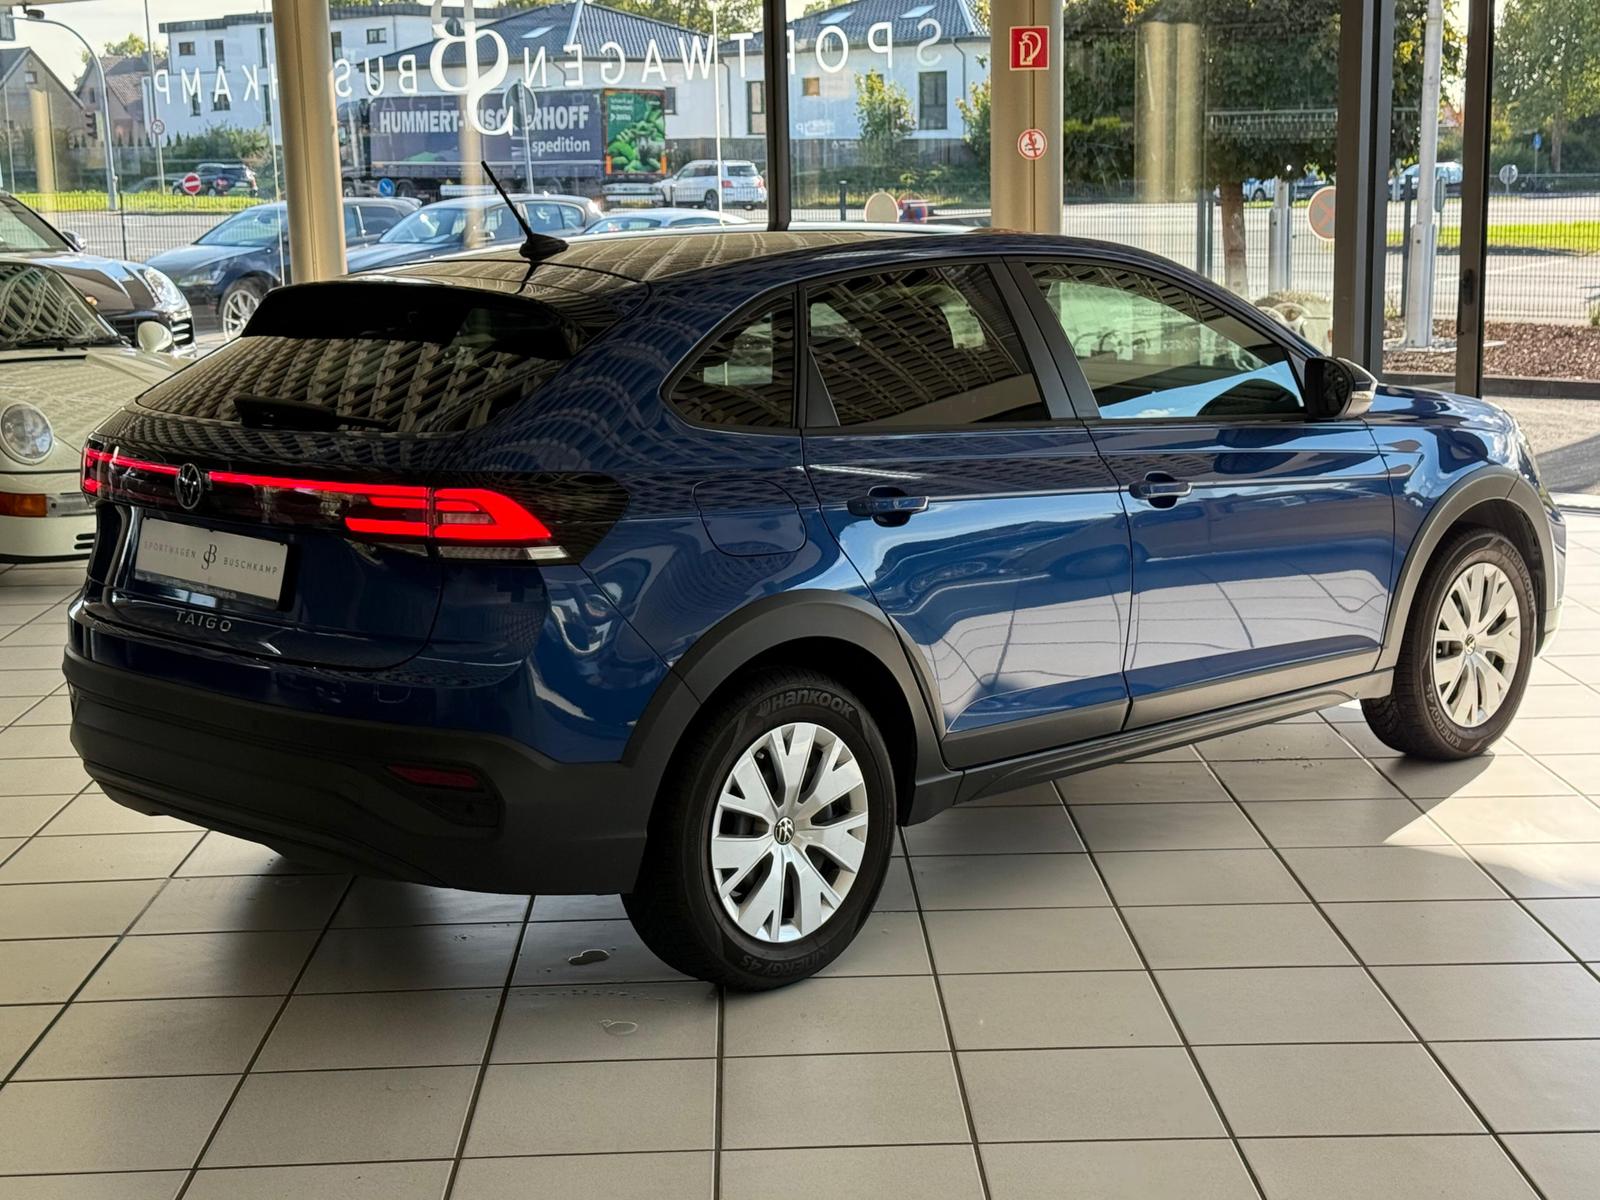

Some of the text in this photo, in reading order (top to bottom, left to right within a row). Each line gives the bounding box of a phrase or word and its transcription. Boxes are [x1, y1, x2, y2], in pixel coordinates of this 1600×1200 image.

[531, 136, 591, 157] spedition
[143, 541, 197, 559] SPORTWAGEN
[223, 557, 279, 575] BUSCHKAMP
[176, 610, 232, 632] TAIGO
